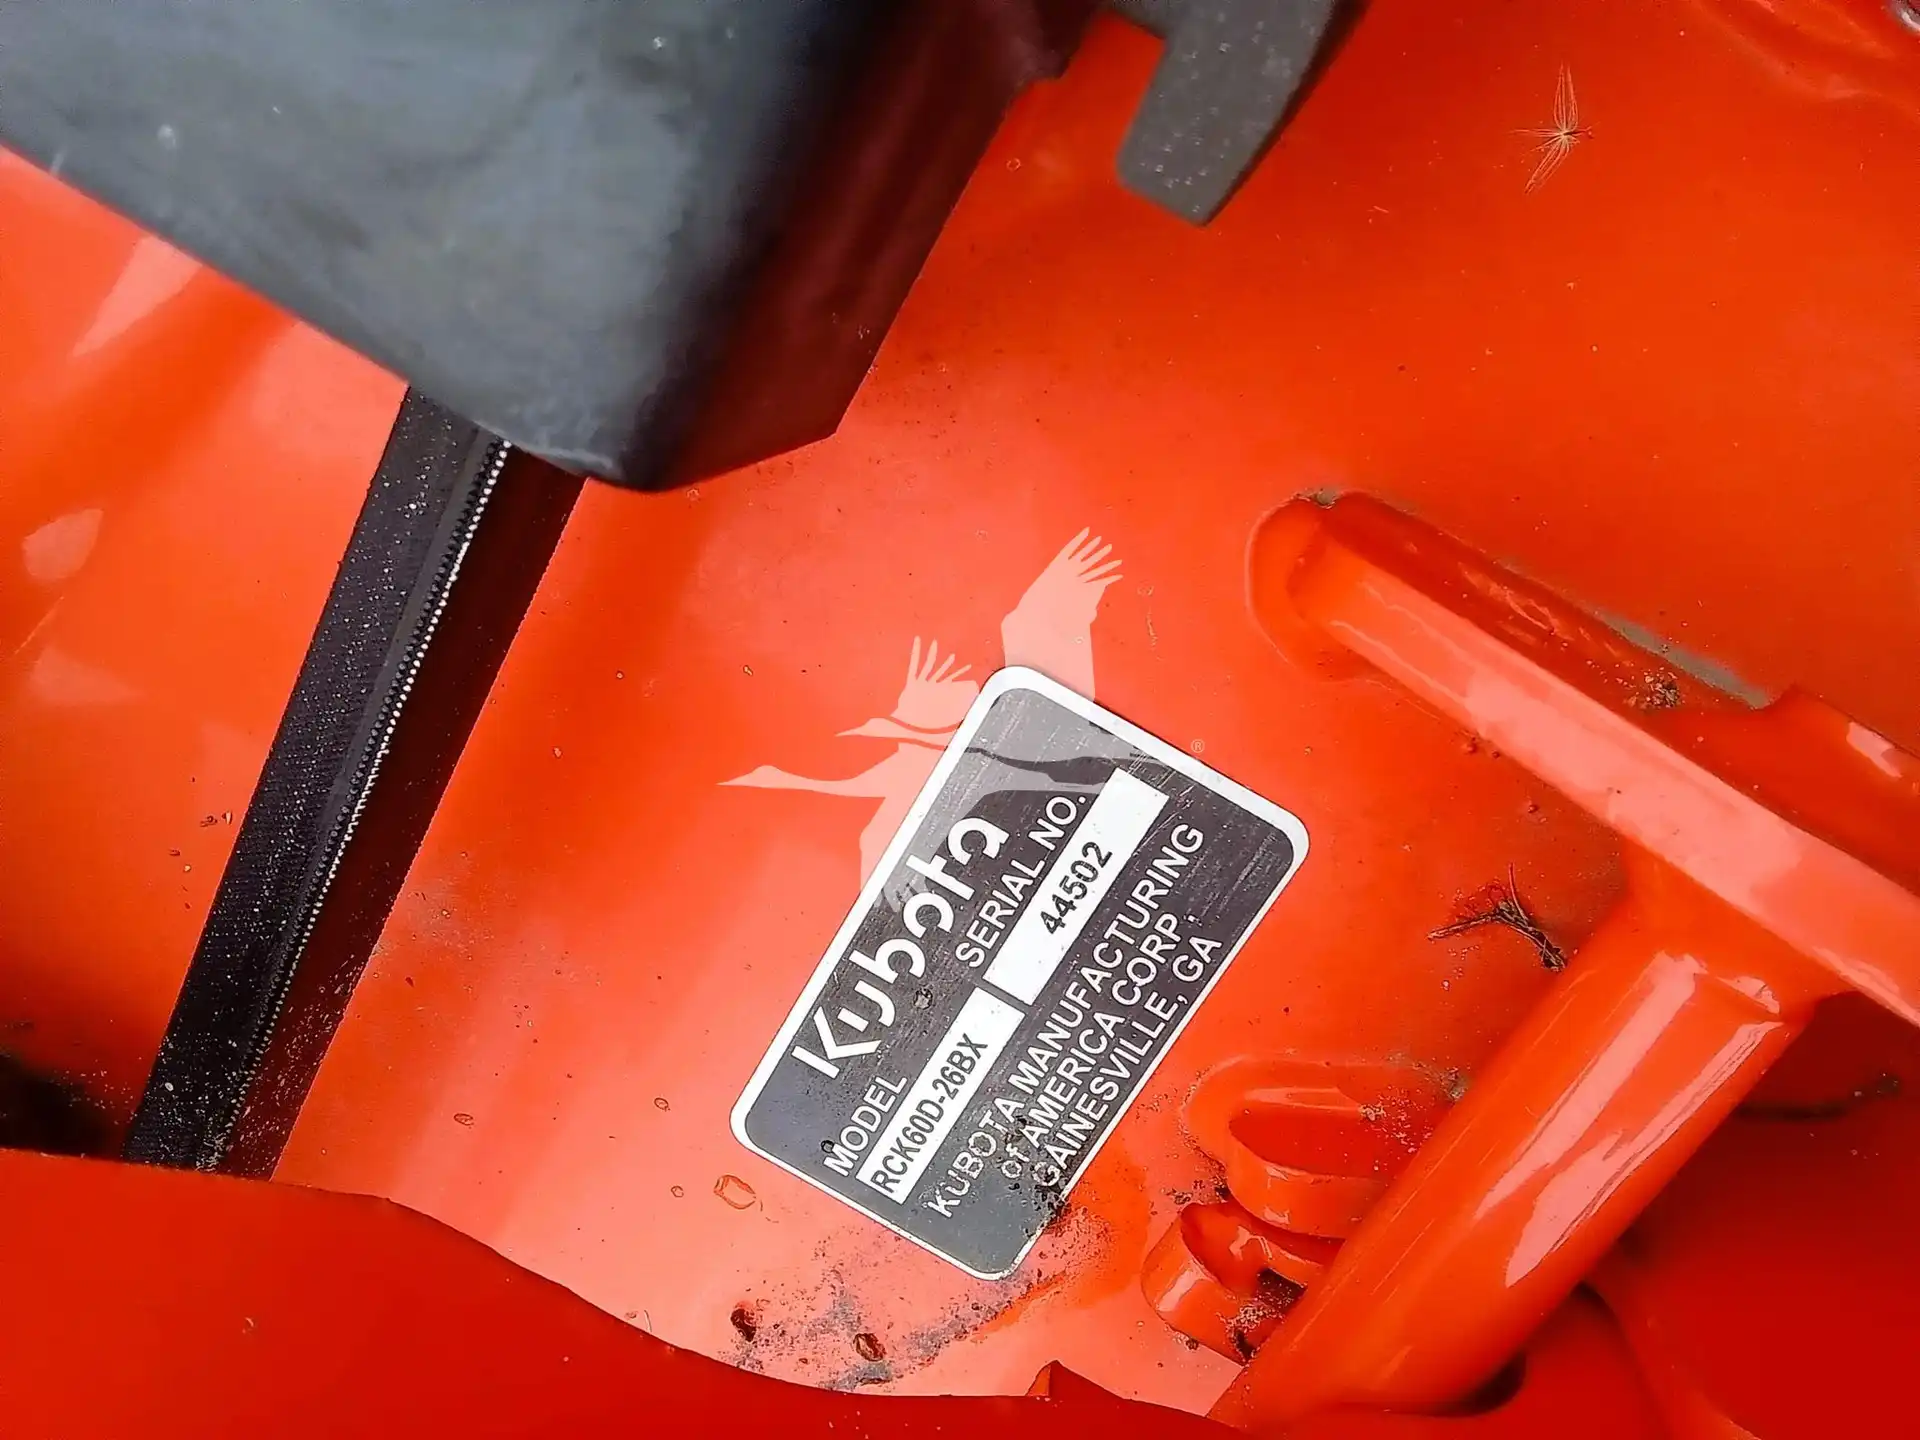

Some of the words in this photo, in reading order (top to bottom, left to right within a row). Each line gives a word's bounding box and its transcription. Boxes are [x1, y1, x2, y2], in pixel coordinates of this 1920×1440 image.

[791, 817, 1009, 1079] Kubota
[955, 859, 1045, 968] SERIAL
[1028, 793, 1086, 851] NO.
[1041, 842, 1112, 936] 44502
[927, 1097, 1025, 1218] KUBOTA
[1007, 824, 1204, 1095] MANUFACTURING
[1001, 1143, 1030, 1179] of
[1019, 1012, 1125, 1149] AMERICA
[1032, 992, 1189, 1187] GAINESVILLE,
[1172, 937, 1223, 982] GA
[823, 1073, 907, 1178] MODEL
[872, 1033, 988, 1197] RCK60D-26BX
